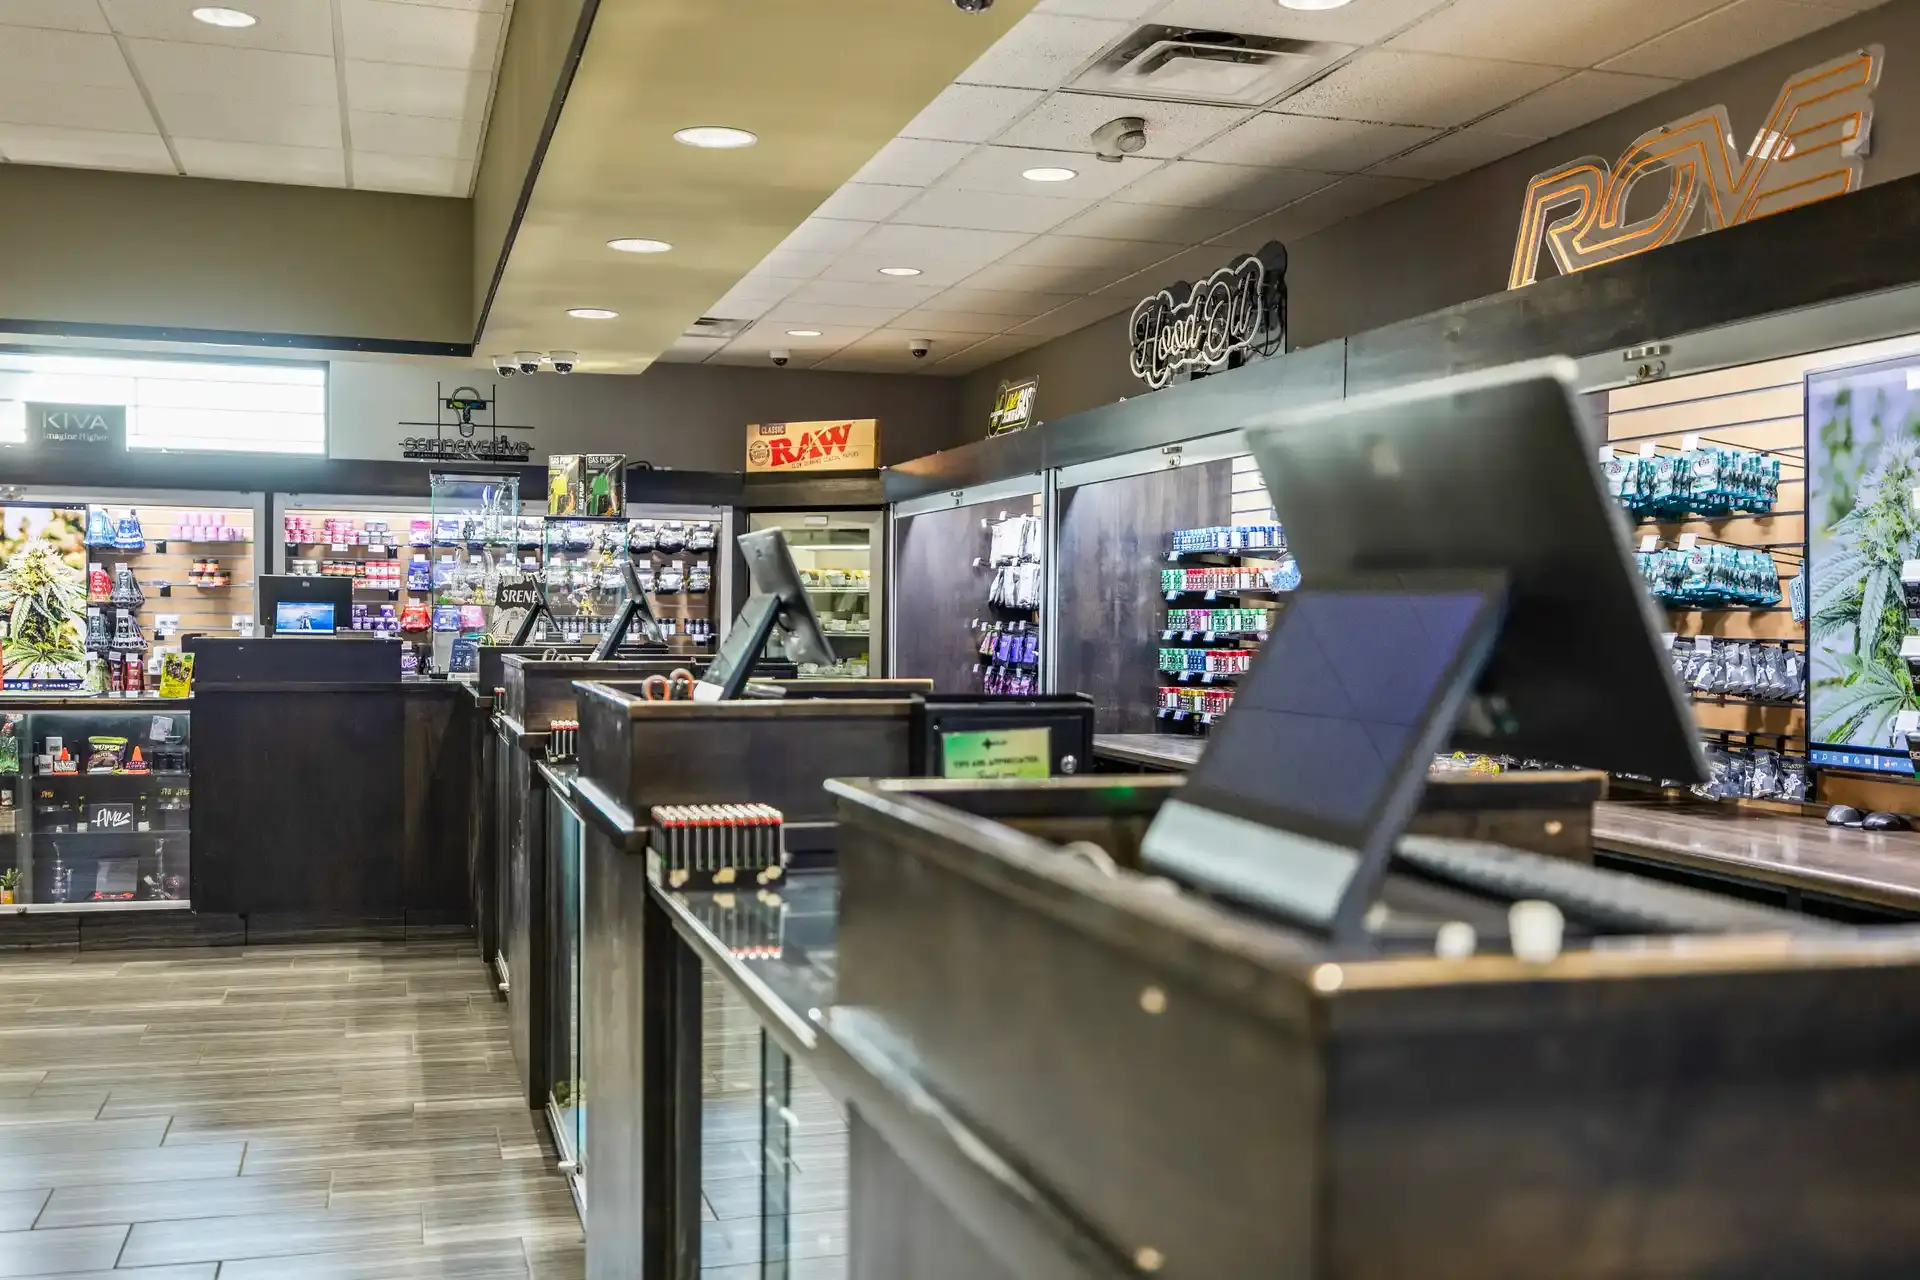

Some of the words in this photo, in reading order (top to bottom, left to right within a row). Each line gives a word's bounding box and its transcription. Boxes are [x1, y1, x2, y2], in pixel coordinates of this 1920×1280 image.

[1507, 52, 1876, 291] ROVE
[1134, 294, 1203, 378] Hood
[42, 411, 108, 430] KIVA
[761, 425, 784, 435] CLASSIC
[769, 424, 852, 466] RAW
